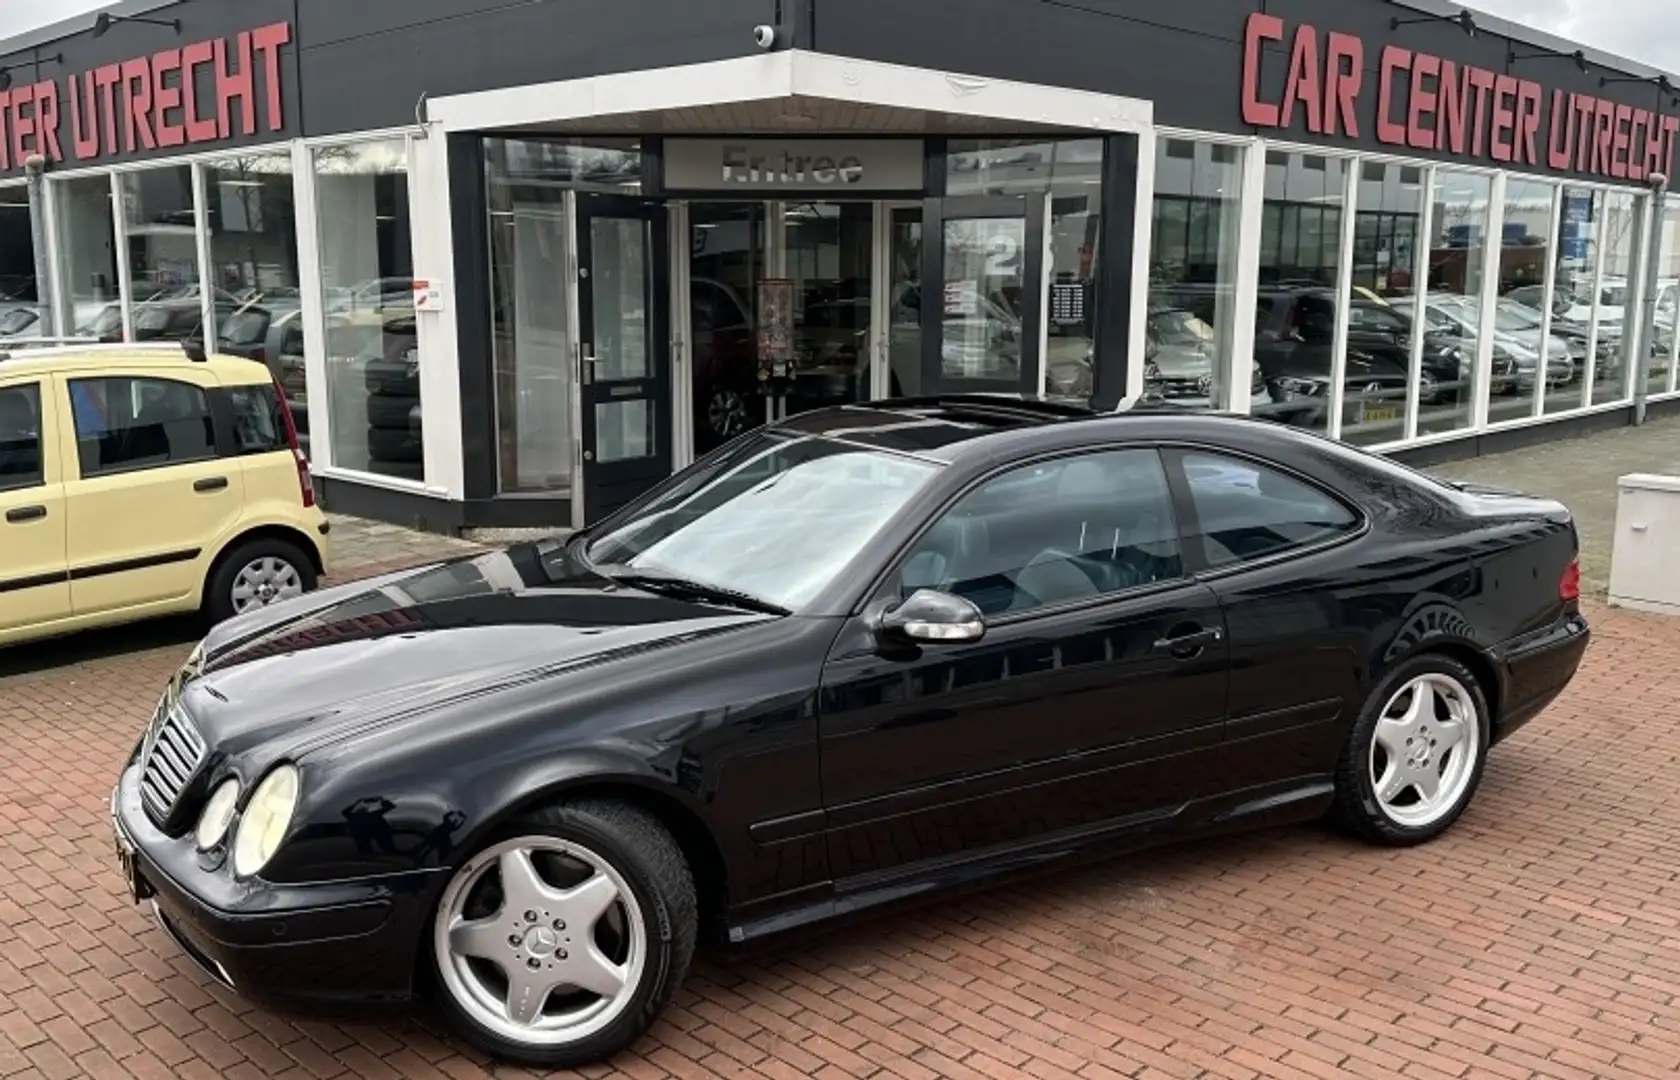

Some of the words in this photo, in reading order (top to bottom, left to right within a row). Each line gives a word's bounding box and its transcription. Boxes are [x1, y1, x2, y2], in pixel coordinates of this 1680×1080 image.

[68, 21, 289, 160] UTRECHT
[1242, 12, 1363, 138] CAR
[1377, 45, 1541, 165] CENTER
[1549, 88, 1680, 182] UTRECHT
[722, 145, 863, 183] Entree
[984, 234, 1017, 276] 2
